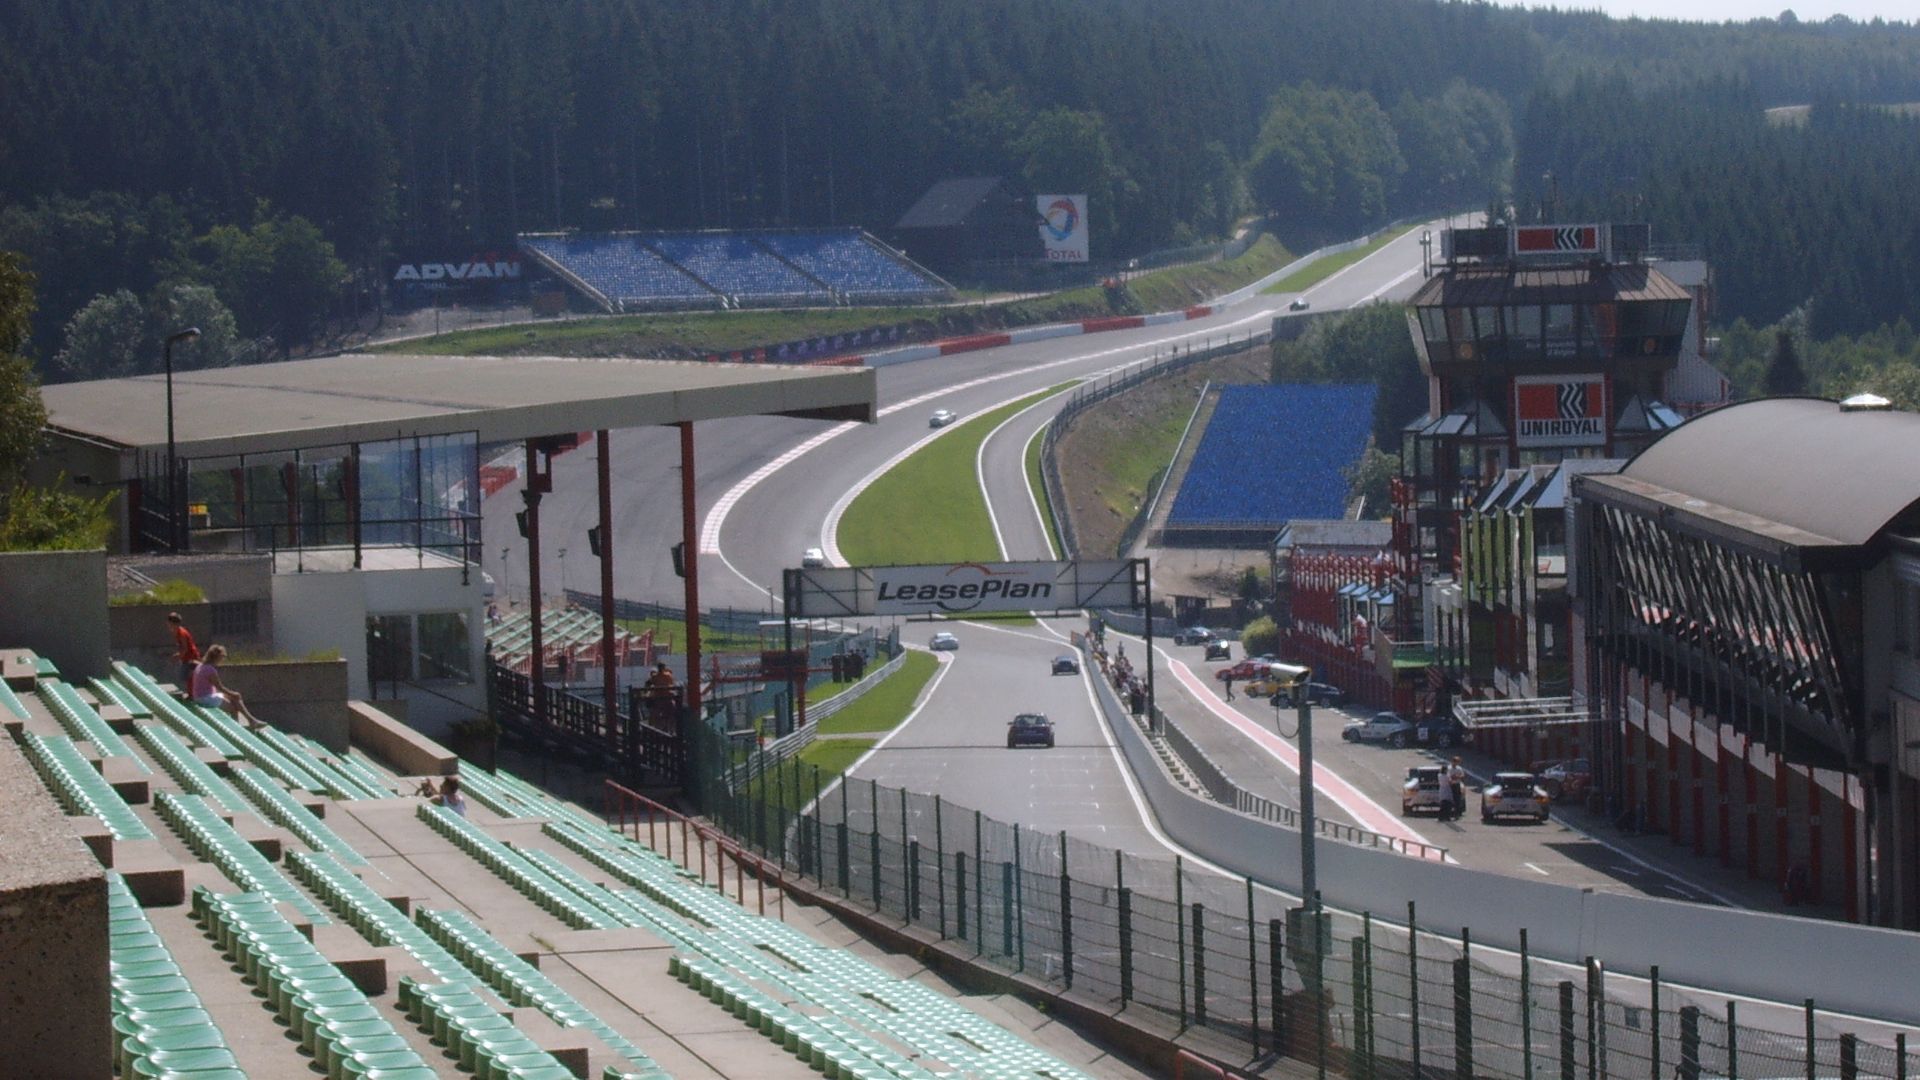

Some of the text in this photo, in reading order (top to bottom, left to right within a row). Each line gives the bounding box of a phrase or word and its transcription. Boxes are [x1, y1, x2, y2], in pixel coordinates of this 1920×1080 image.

[394, 262, 521, 280] ADVAN
[1520, 419, 1601, 436] UNIROYAL
[877, 580, 1052, 602] LeasePlan
